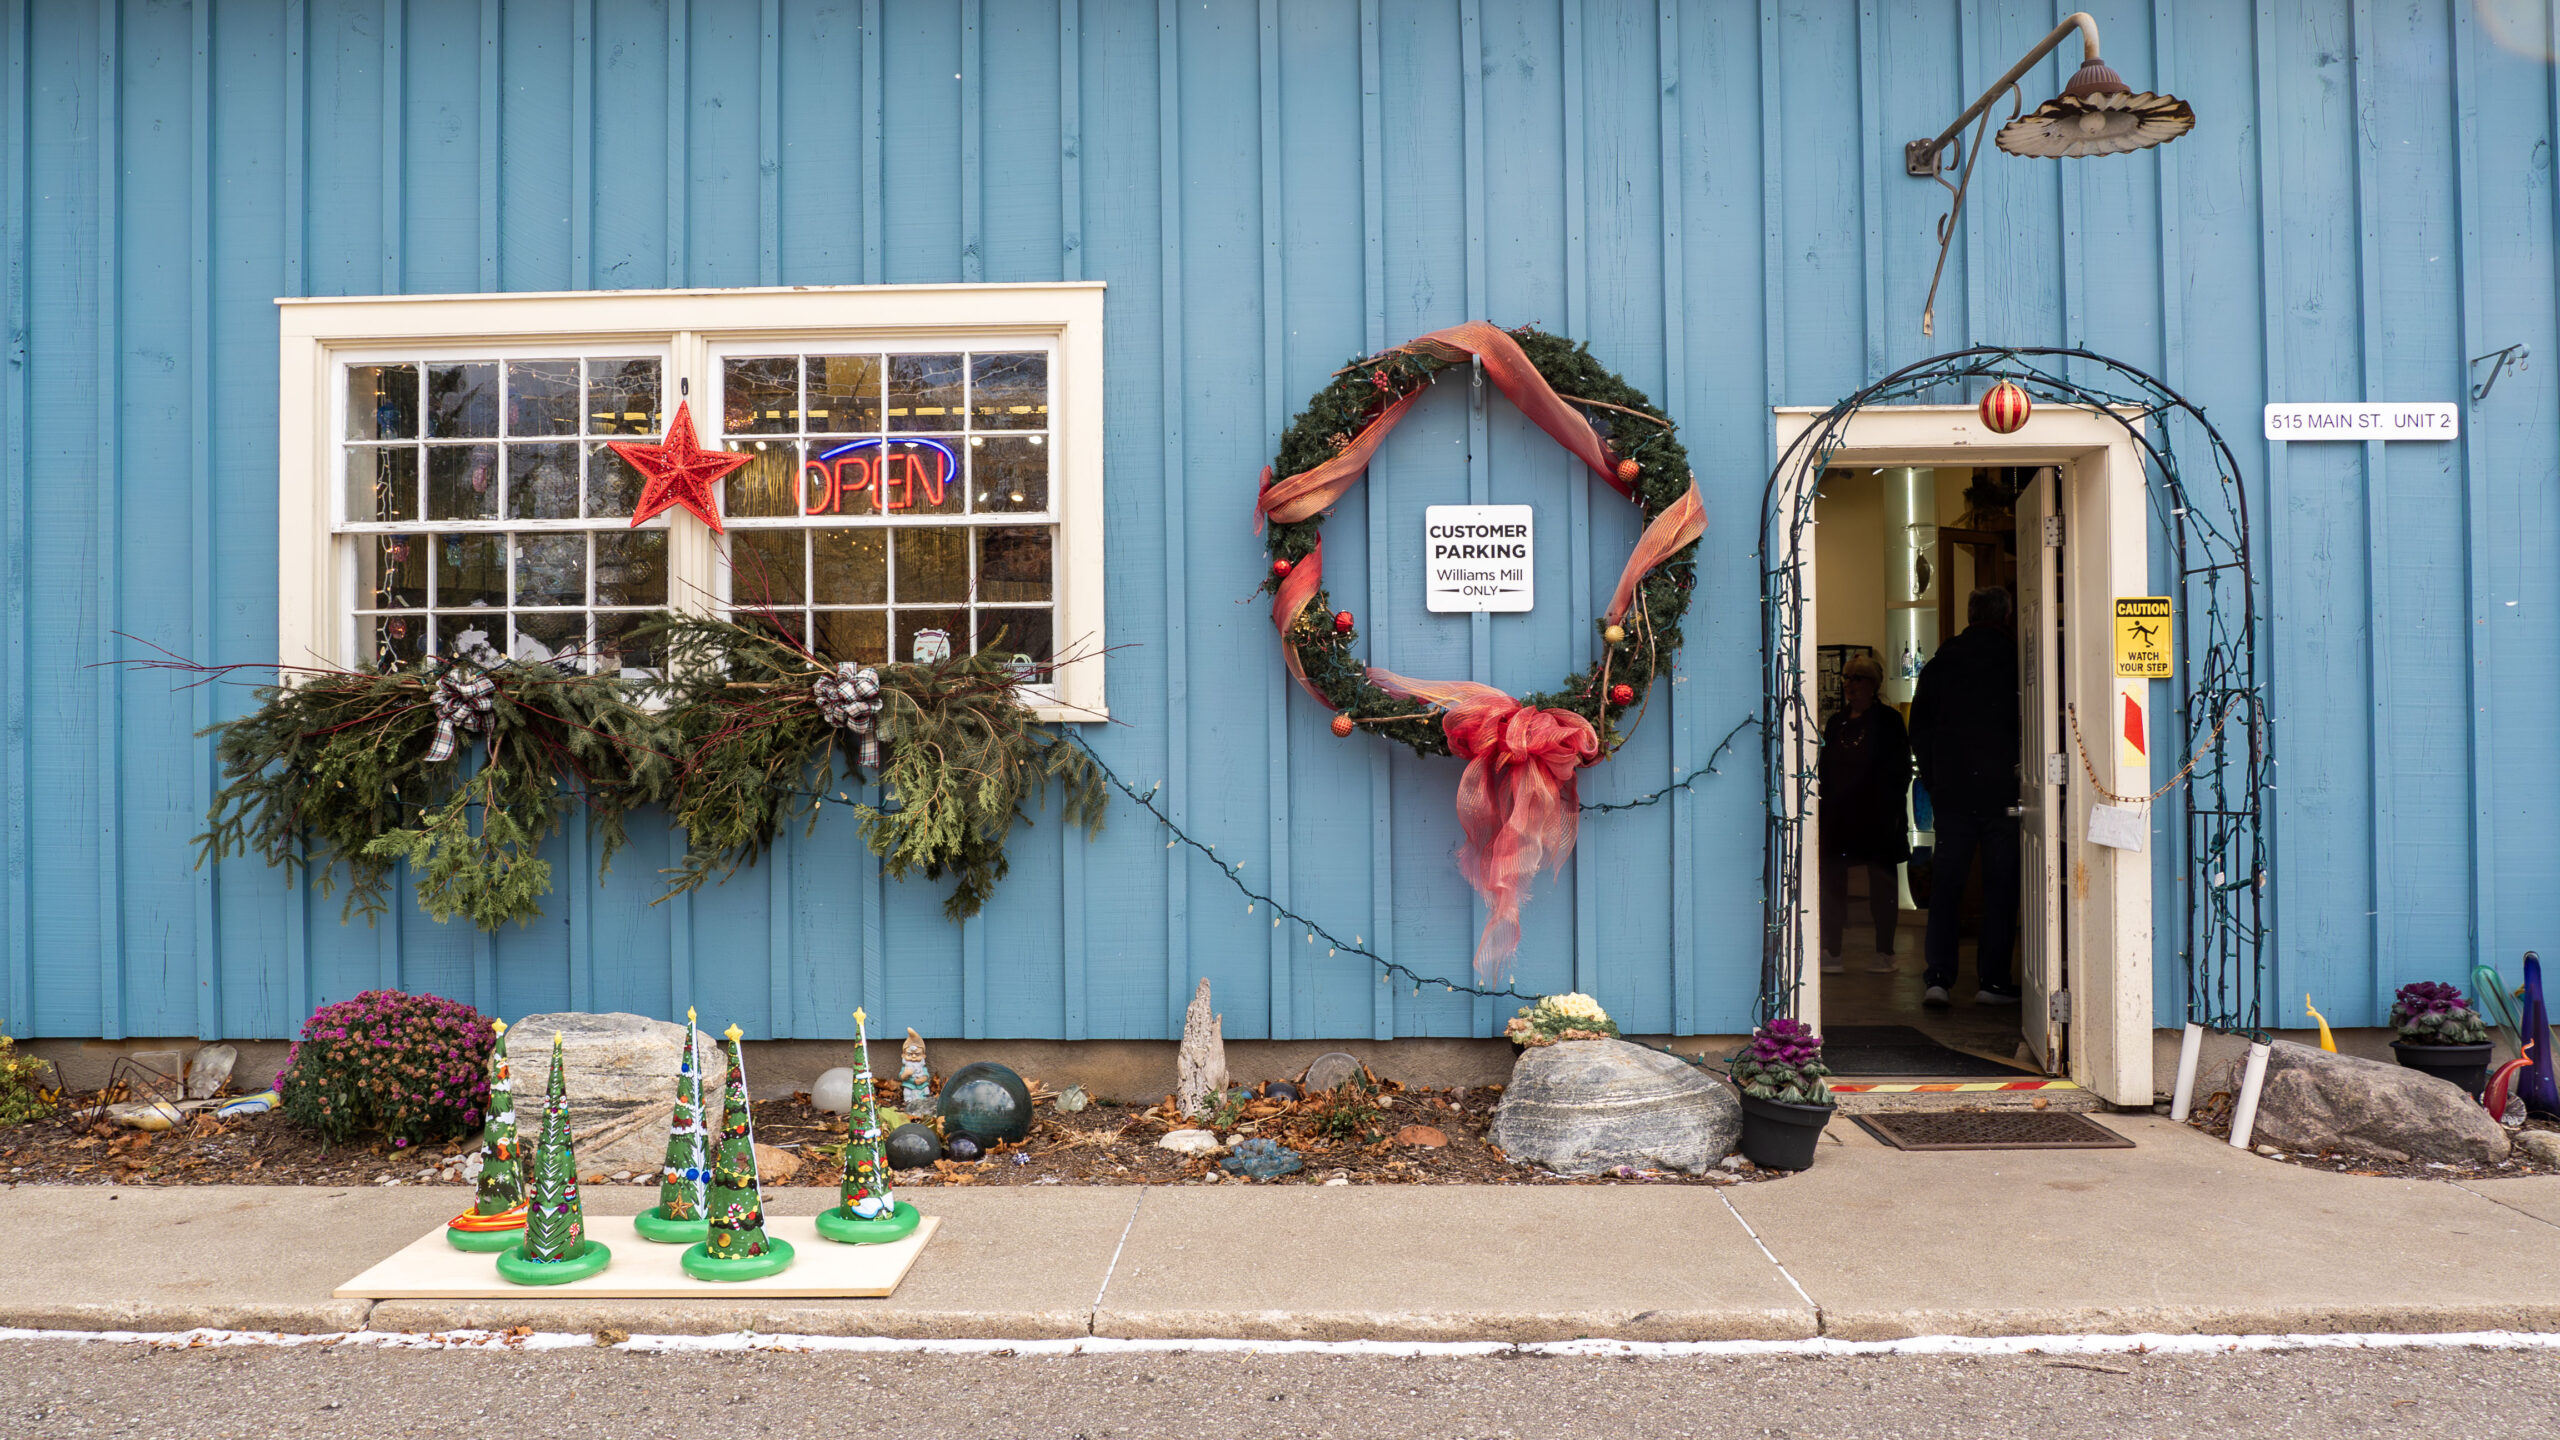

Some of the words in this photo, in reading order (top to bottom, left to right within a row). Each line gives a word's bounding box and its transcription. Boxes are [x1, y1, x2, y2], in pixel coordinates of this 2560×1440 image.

[2272, 414, 2303, 429] 515
[2308, 413, 2352, 429] MAIN
[2358, 413, 2383, 428] ST.
[2394, 413, 2436, 428] UNIT
[2440, 413, 2450, 428] 2
[794, 451, 945, 515] OPEN
[1429, 525, 1528, 539] CUSTOMER
[1435, 544, 1526, 559] PARKING
[1436, 568, 1496, 581] Williams
[1500, 568, 1523, 581] Mill
[1463, 585, 1498, 596] ONLY
[2117, 603, 2169, 616] CAUTION
[2128, 651, 2160, 661] WATCH
[2120, 662, 2144, 672] YOUR
[2146, 662, 2168, 672] STEP
